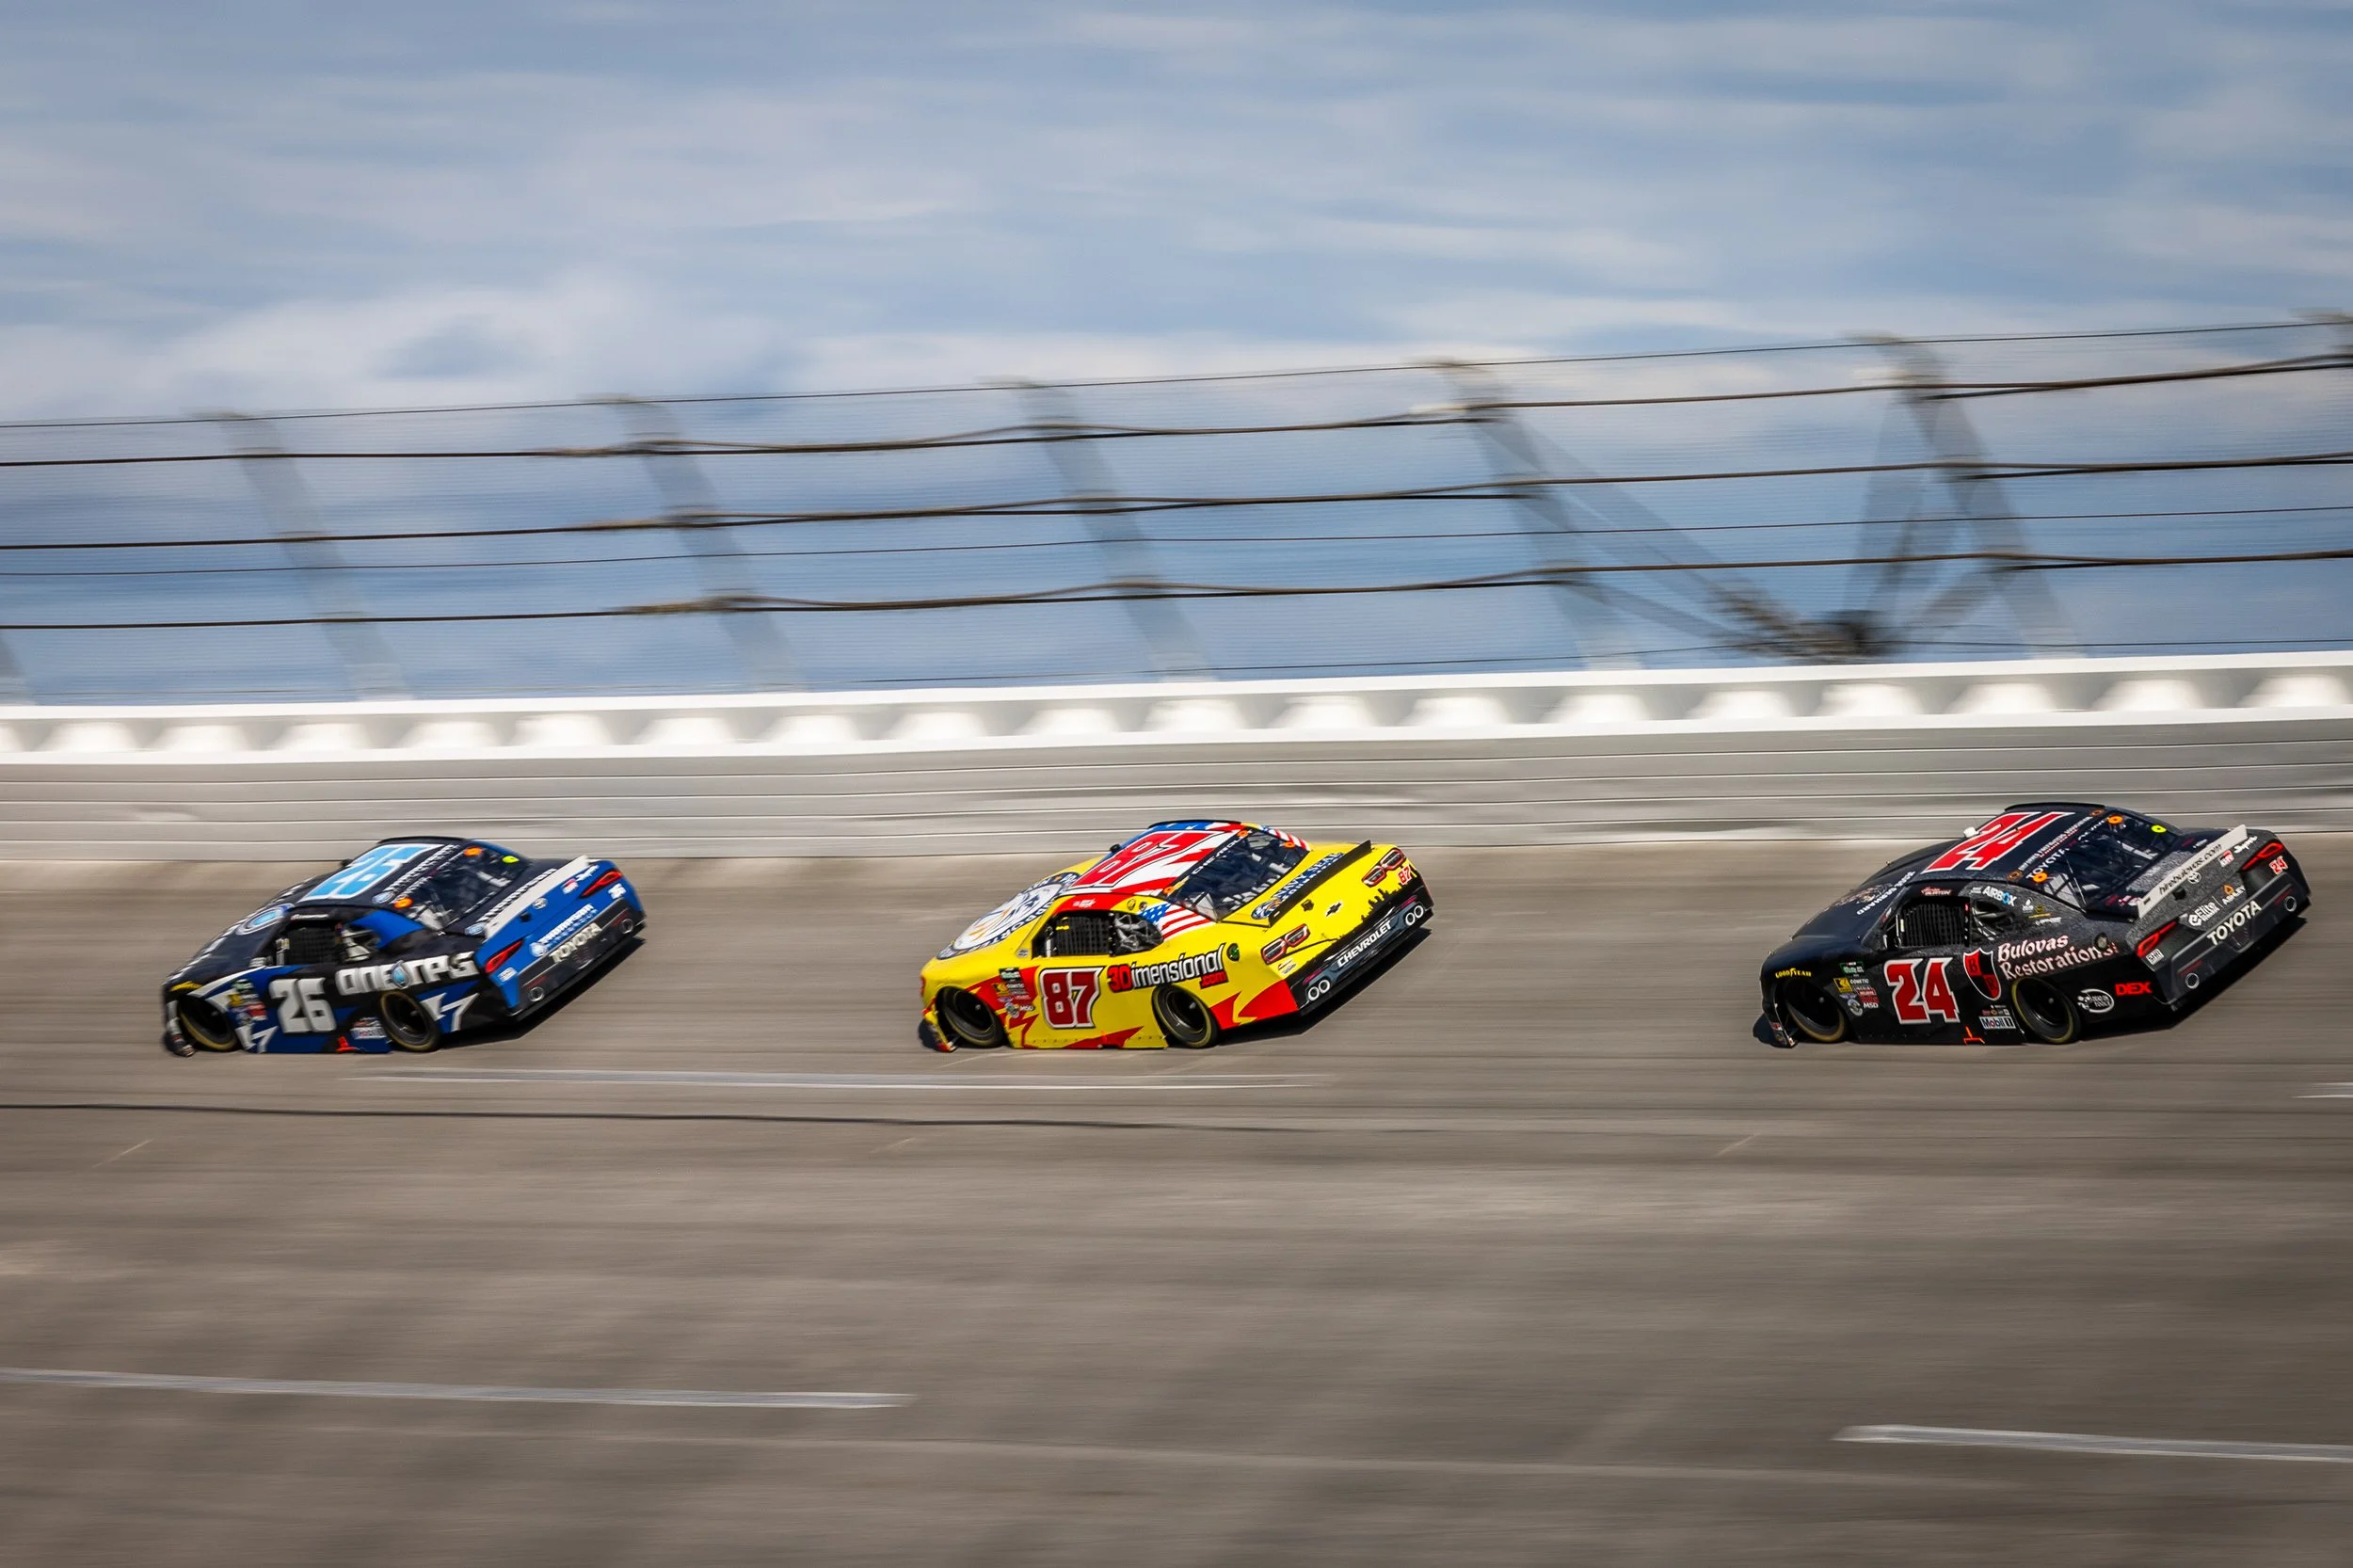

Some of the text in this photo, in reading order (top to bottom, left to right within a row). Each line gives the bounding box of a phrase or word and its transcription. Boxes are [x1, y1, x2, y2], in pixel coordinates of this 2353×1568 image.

[1065, 830, 1226, 891] 87
[1920, 811, 2075, 873] 24
[1397, 866, 1413, 886] 87
[2268, 856, 2289, 874] 24
[1982, 886, 2017, 906] AIRBOX
[549, 922, 602, 964] TOYOTA
[1337, 920, 1392, 968] CHEVROLET
[2207, 900, 2263, 946] TOYOTA
[1998, 935, 2069, 962] Bulovas
[1775, 968, 1812, 979] GOODYEAR
[1884, 957, 1961, 1024] 24
[2115, 982, 2153, 996] DEX
[269, 977, 337, 1033] 26
[1038, 966, 1106, 1030] 87
[1980, 1016, 2004, 1028] Mobil
